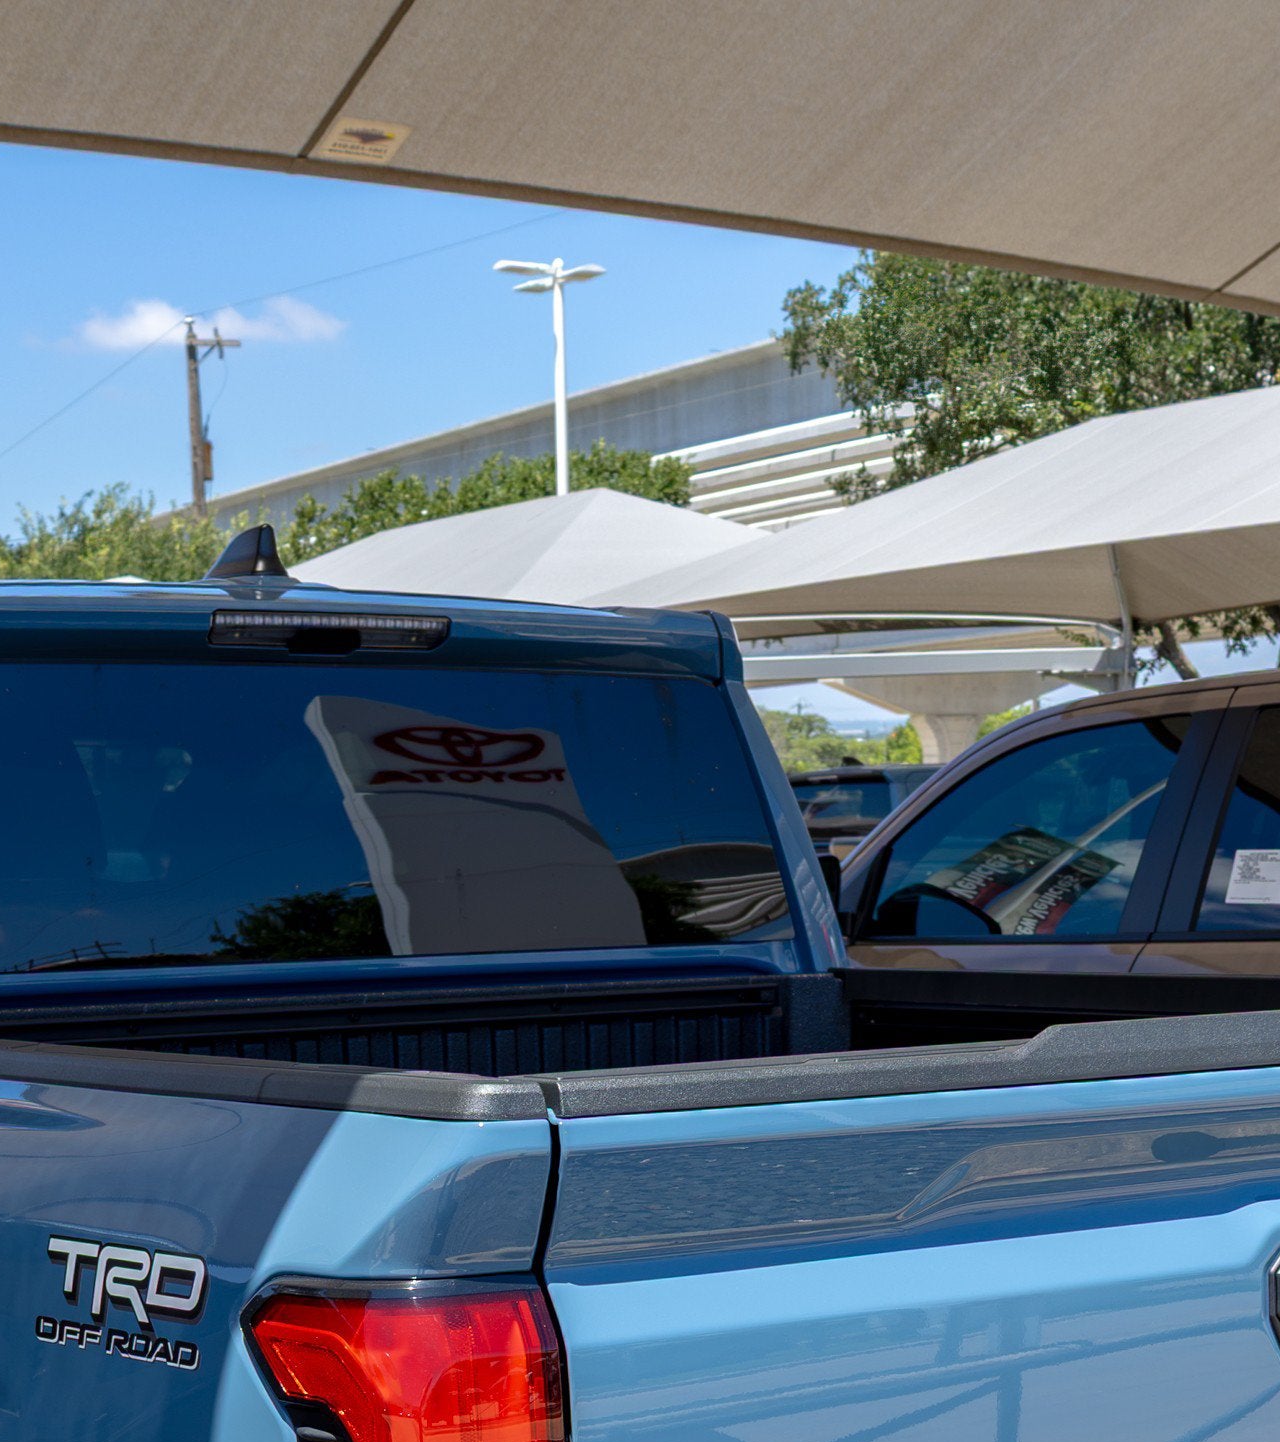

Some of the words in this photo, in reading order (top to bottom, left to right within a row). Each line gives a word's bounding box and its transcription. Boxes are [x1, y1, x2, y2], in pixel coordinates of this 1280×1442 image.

[47, 1235, 209, 1332] TRD
[35, 1316, 102, 1350] OFF
[106, 1328, 200, 1370] ROAD
